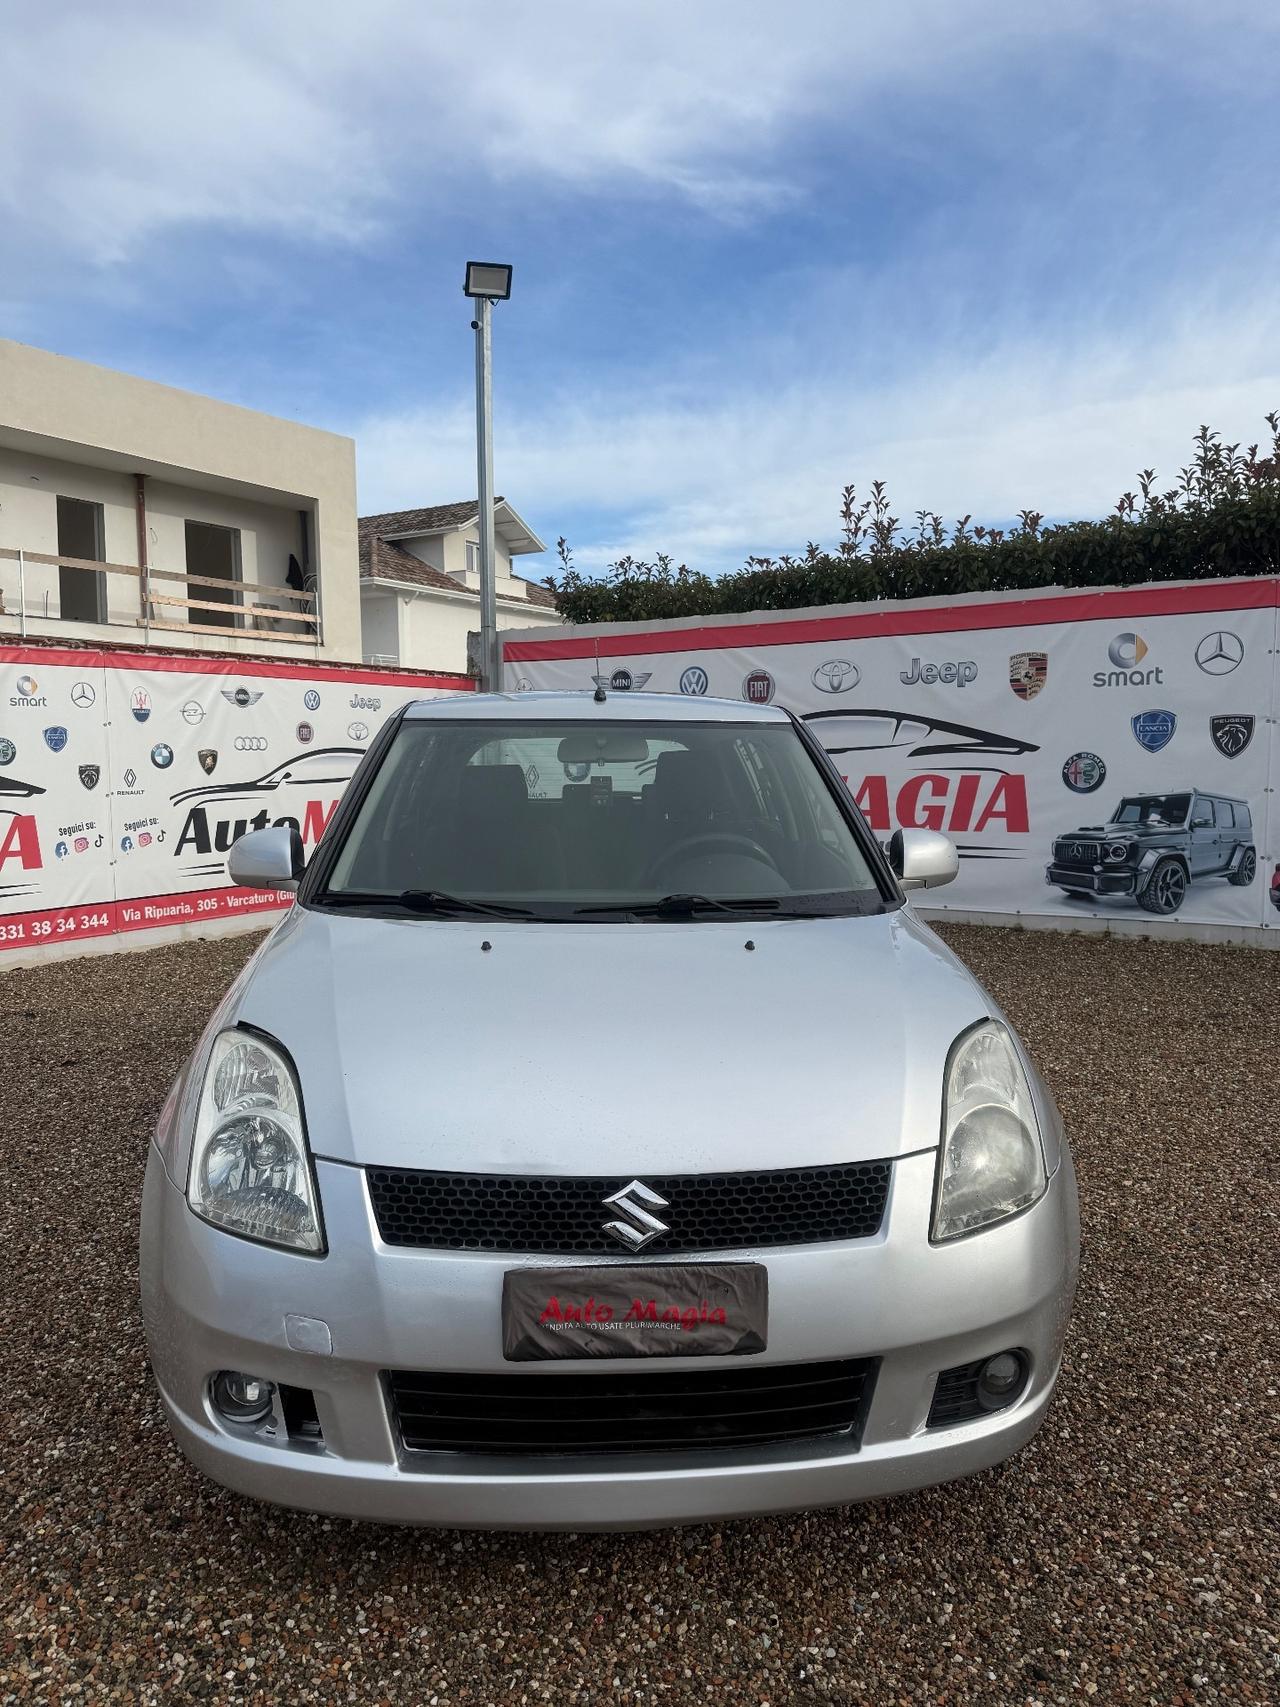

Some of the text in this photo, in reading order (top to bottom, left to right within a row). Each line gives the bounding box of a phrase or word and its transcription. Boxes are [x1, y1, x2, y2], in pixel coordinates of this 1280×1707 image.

[901, 658, 978, 687] Jeep
[1093, 667, 1163, 688] smart
[612, 678, 631, 688] MINI
[750, 681, 769, 698] FIAT
[9, 697, 47, 707] smart
[350, 694, 381, 711] Jeep
[58, 821, 96, 836] Seguici su:
[124, 817, 159, 832] Seguici su:
[122, 908, 141, 922] Via
[145, 902, 194, 919] Ripuaria,
[197, 898, 218, 912] 305
[226, 893, 274, 908] Varcaturo
[0, 912, 109, 940] 331 38 34 344
[540, 1296, 727, 1332] Auto Magia
[599, 1322, 623, 1331] USATE
[625, 1322, 681, 1331] PLURIMARCHE
